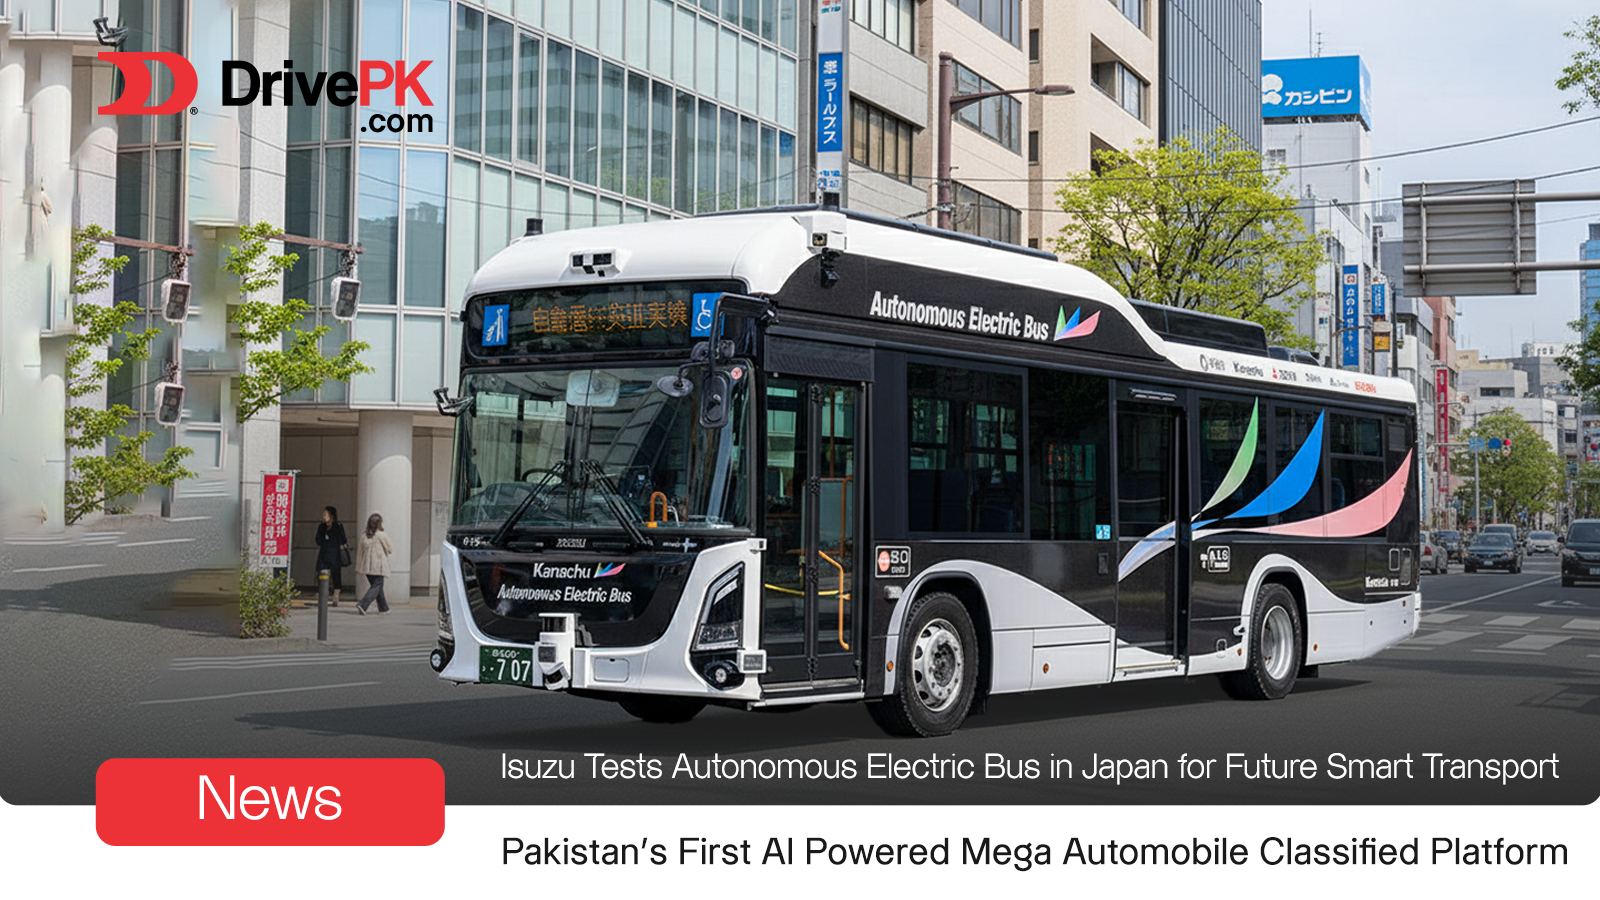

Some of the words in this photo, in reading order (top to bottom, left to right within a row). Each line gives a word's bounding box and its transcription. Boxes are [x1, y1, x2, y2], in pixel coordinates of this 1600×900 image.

[870, 290, 966, 330] Autonomous
[968, 305, 1021, 337] Electric
[1023, 313, 1050, 341] Bus
[563, 586, 607, 603] Electric
[608, 587, 633, 603] Bus
